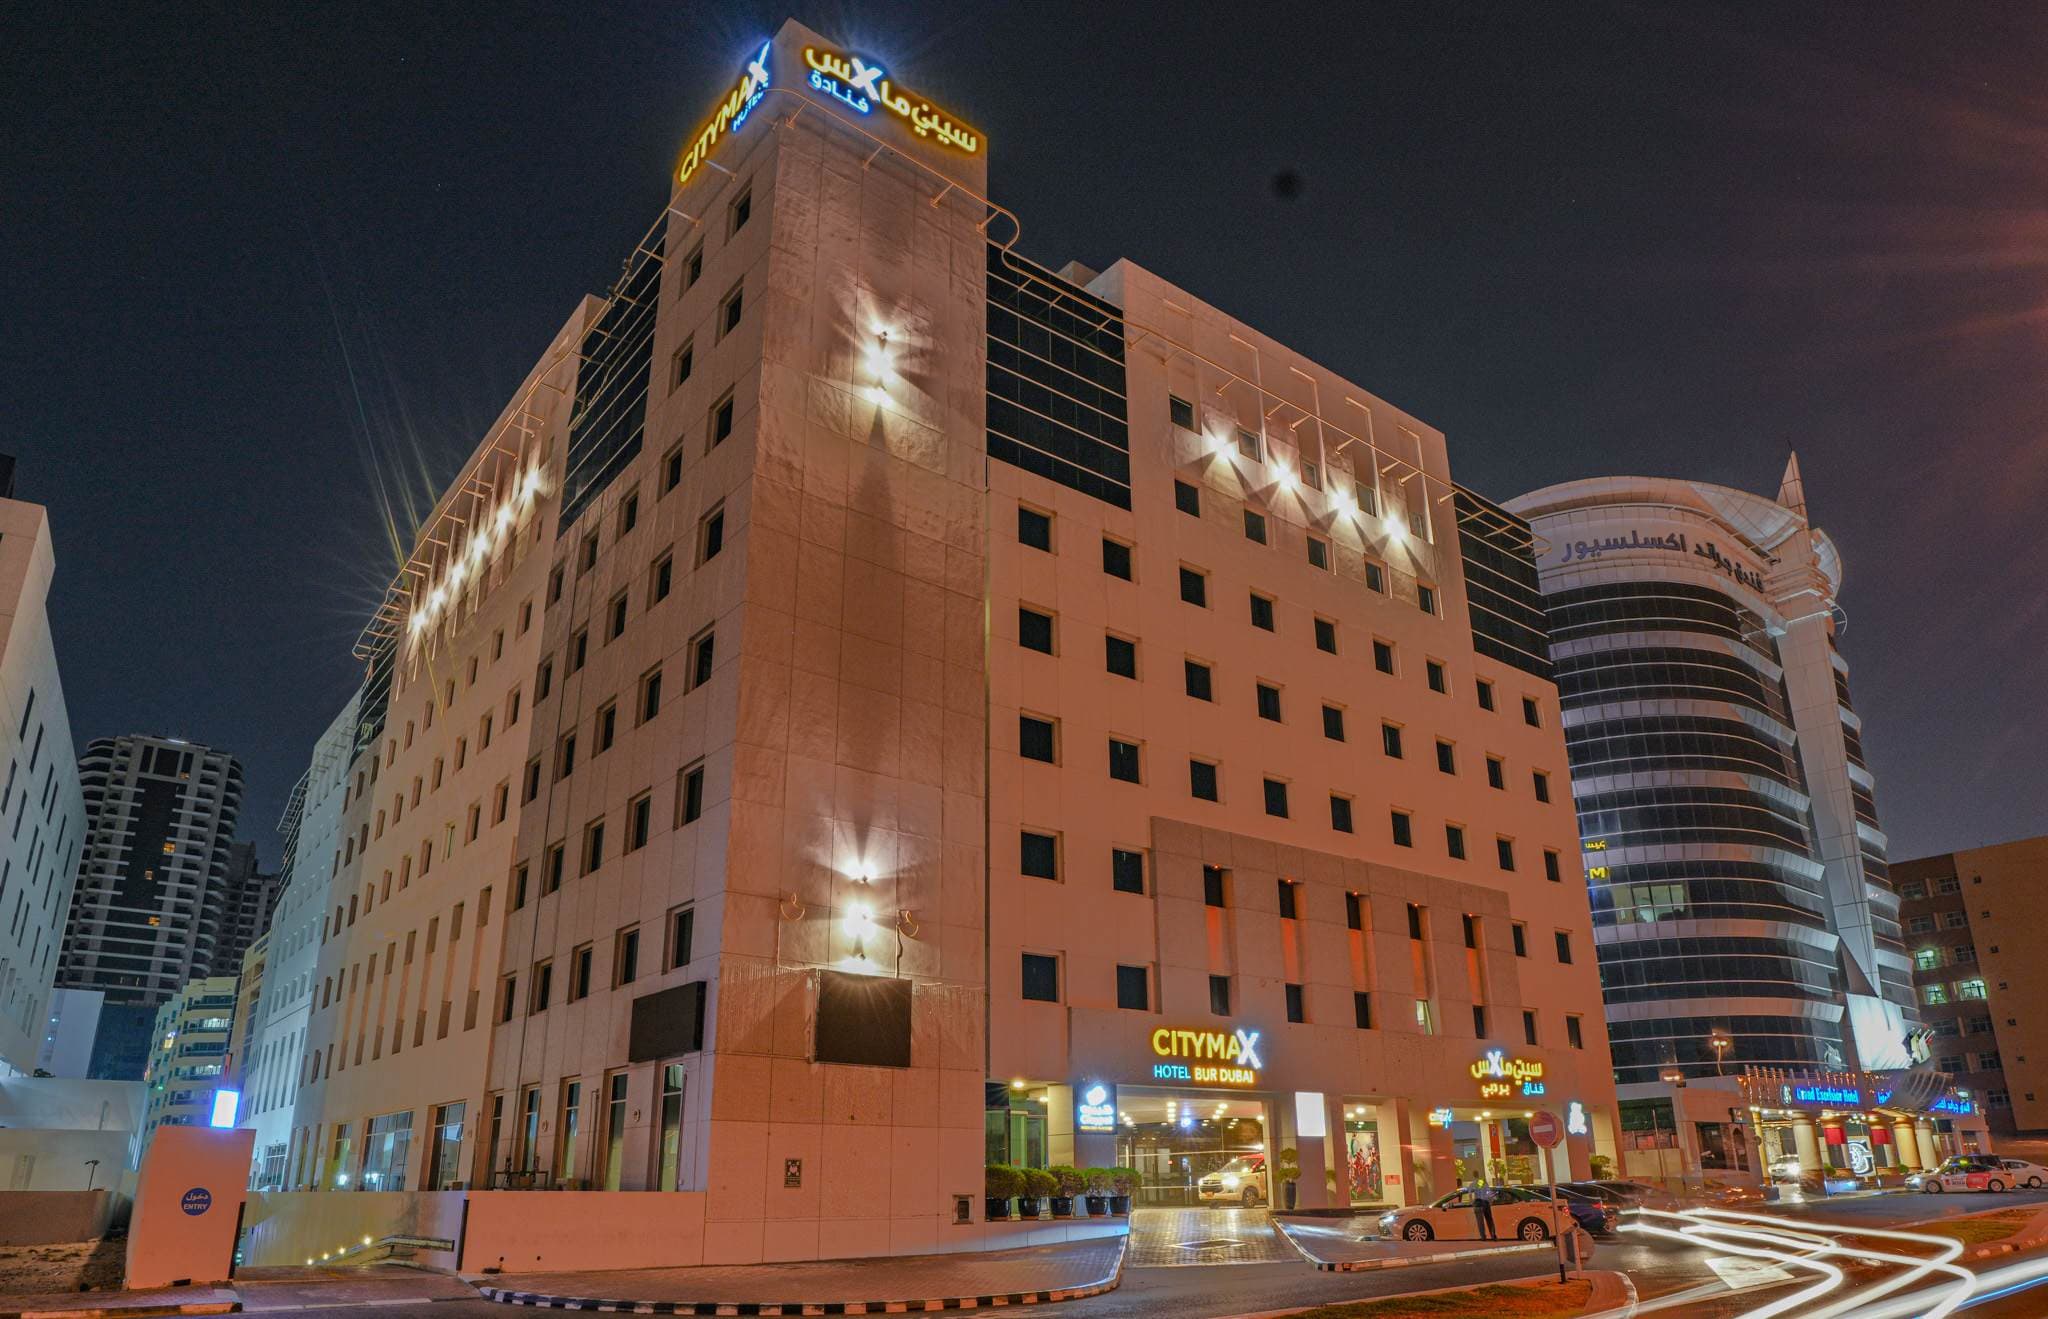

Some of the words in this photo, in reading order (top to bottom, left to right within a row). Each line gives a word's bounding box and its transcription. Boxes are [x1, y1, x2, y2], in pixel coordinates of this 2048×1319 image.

[680, 40, 770, 182] CITYMAX
[1153, 1029, 1262, 1069] CITYMAX
[1154, 1065, 1191, 1079] HOTEL
[1194, 1067, 1217, 1081] BUR
[1219, 1068, 1254, 1083] DUBAI
